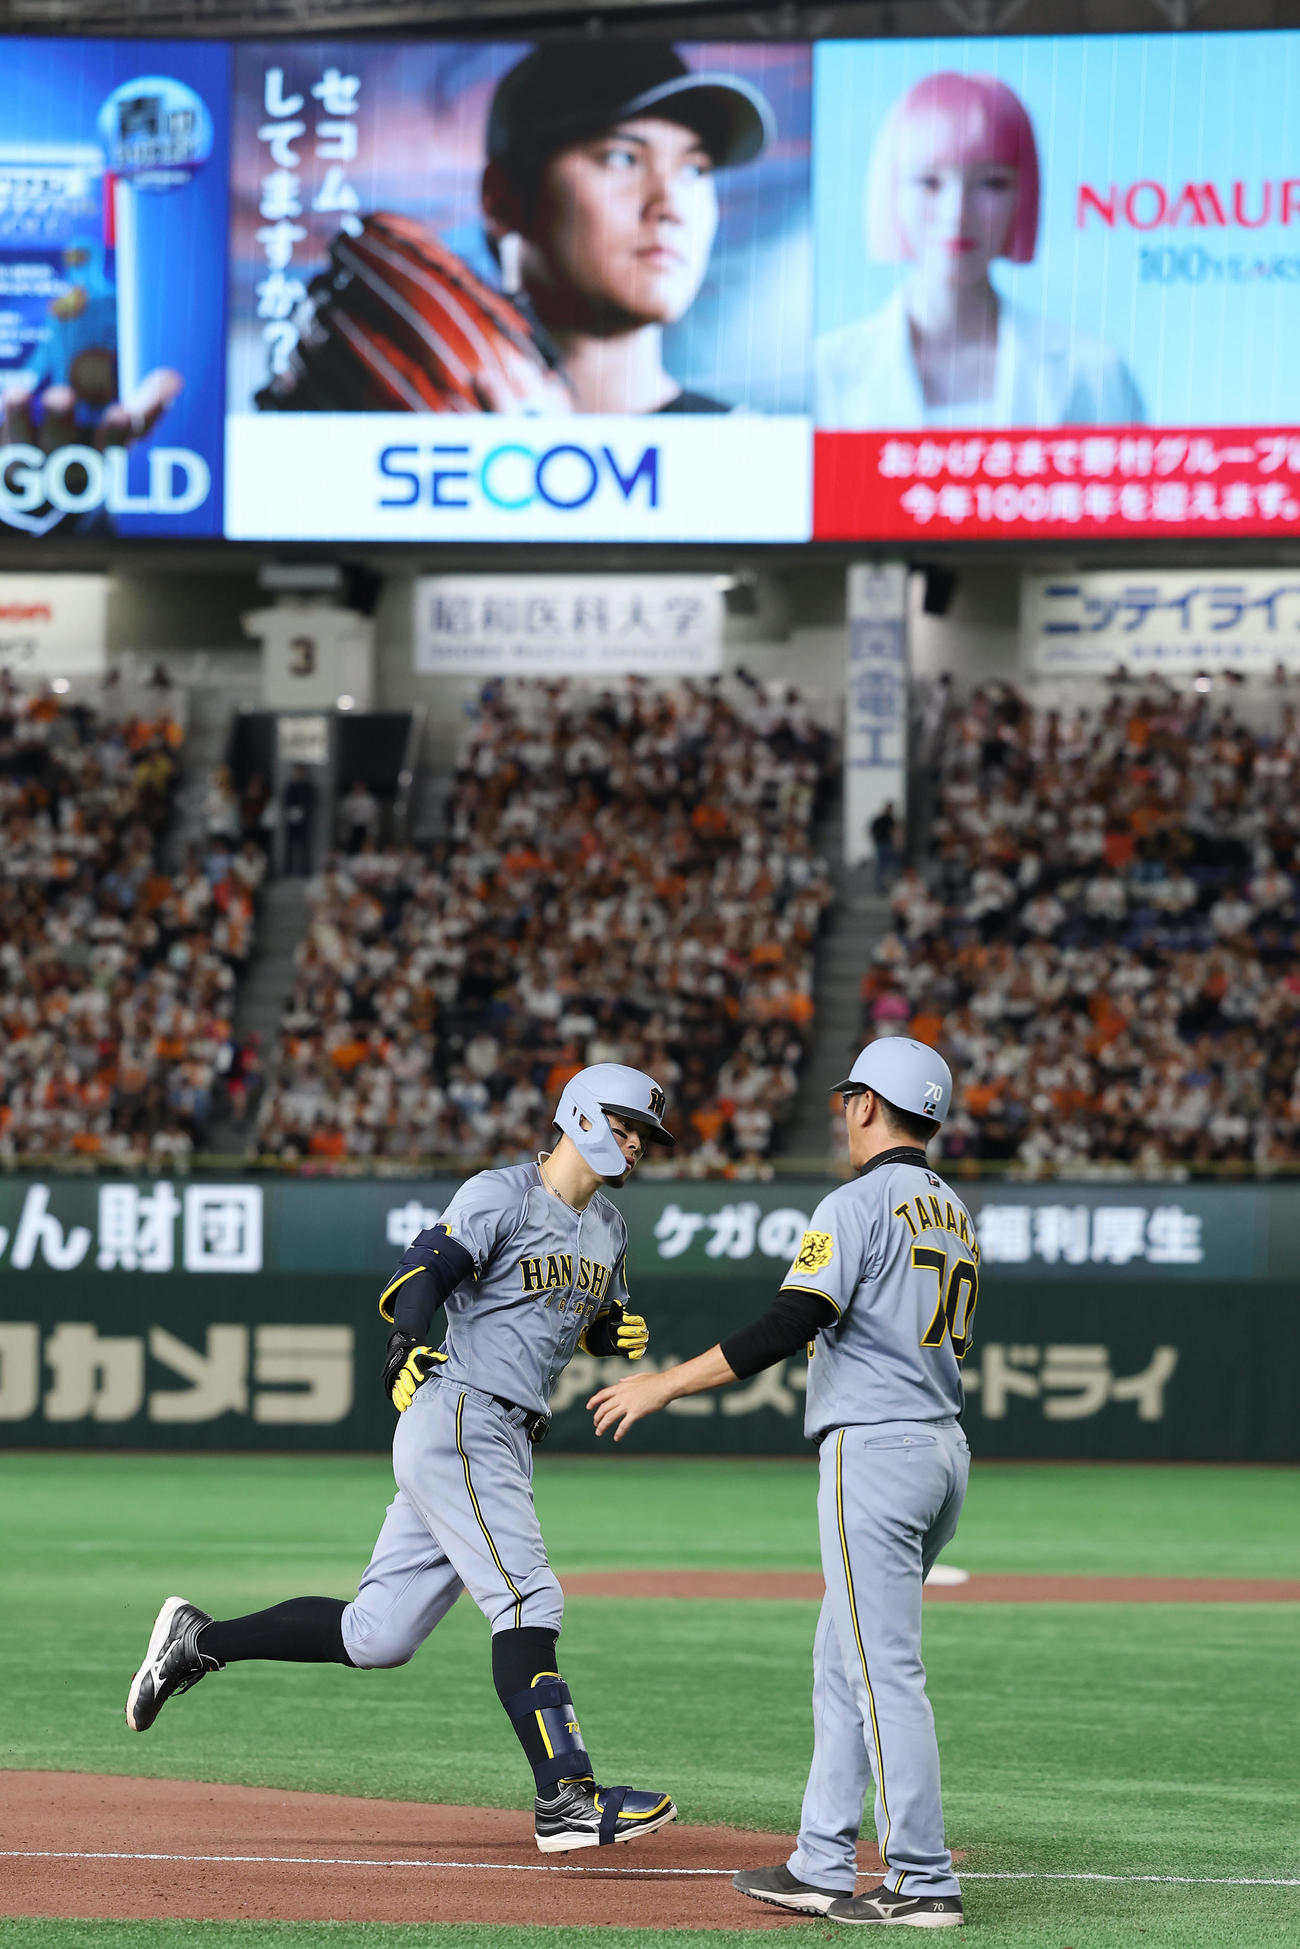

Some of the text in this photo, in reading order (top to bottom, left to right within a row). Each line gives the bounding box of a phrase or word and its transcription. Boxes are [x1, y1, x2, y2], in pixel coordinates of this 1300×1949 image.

[311, 67, 364, 237] セコム、
[0, 442, 211, 514] GOLD
[378, 445, 659, 510] SECOM
[1044, 585, 1300, 632] ニッテイライ
[289, 637, 317, 677] 3
[924, 1081, 944, 1102] 70
[0, 1181, 262, 1273] ん財団
[654, 1202, 809, 1260] ケガの
[911, 1245, 980, 1360] 70
[932, 1902, 945, 1913] 70
